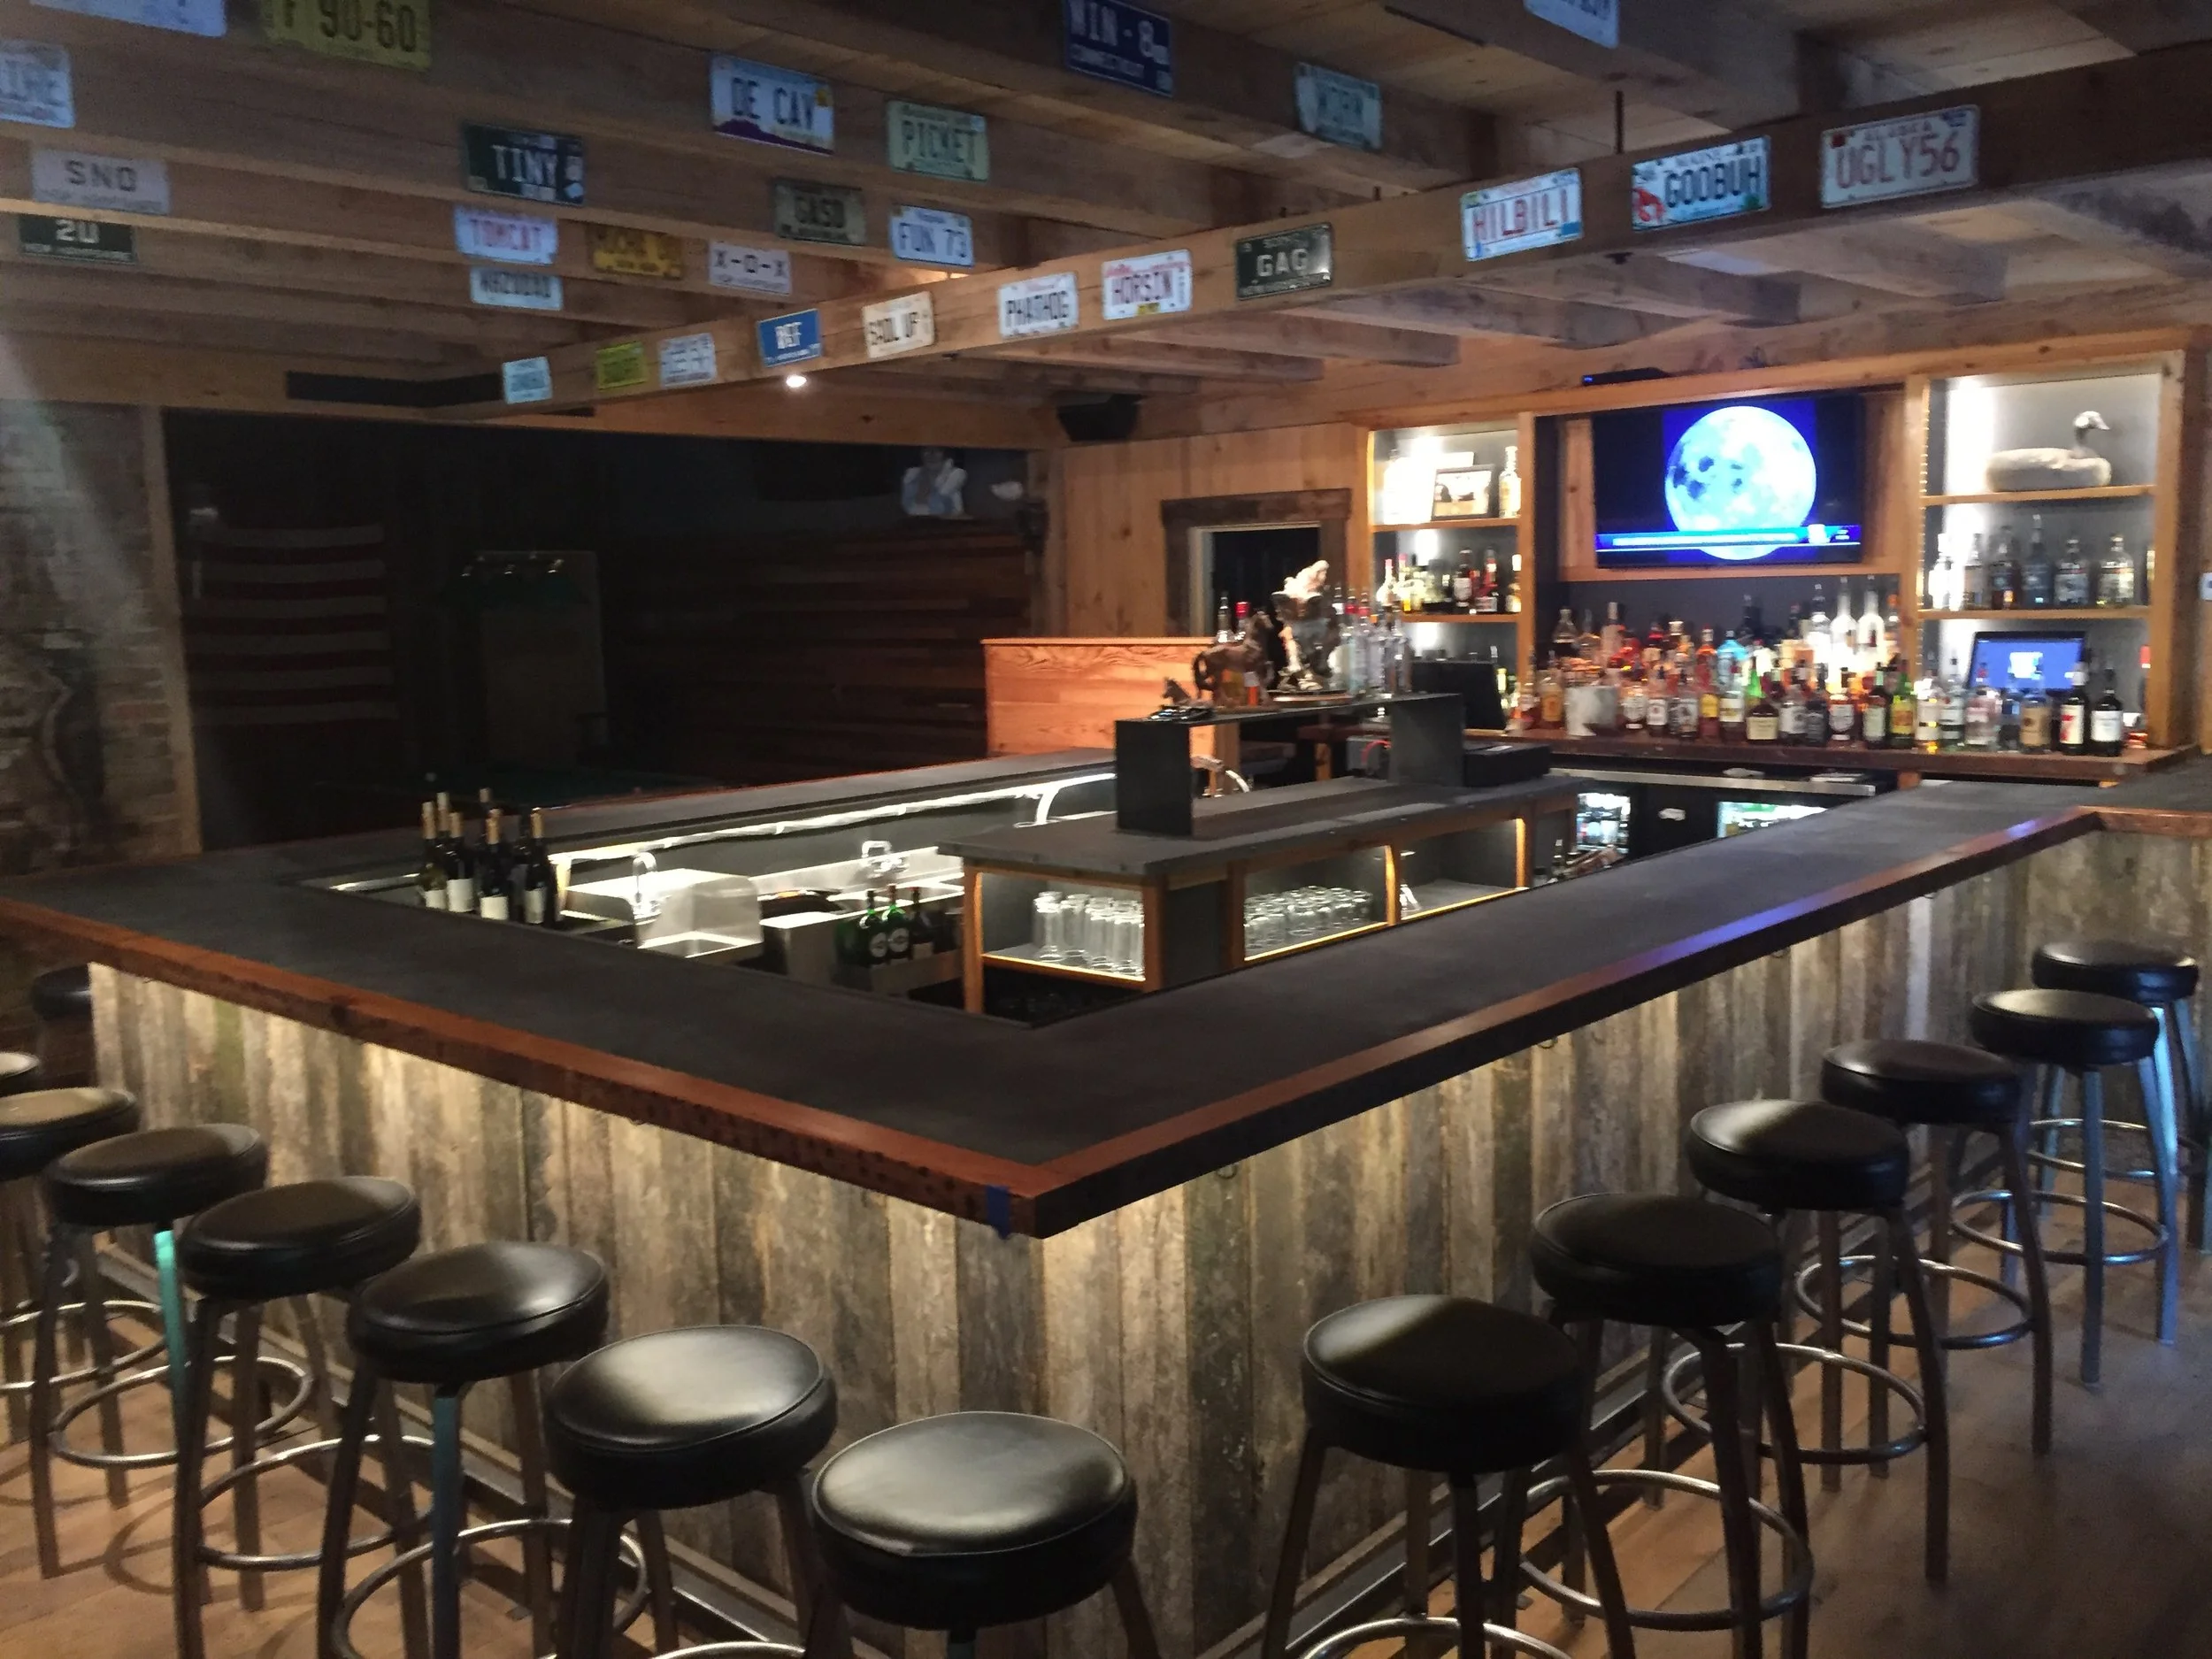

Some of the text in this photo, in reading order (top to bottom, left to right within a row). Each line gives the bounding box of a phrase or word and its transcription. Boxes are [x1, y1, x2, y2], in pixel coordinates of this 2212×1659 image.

[319, 0, 417, 52] 90-60
[731, 76, 813, 130] DE CAY
[65, 159, 136, 192] SNO
[491, 143, 557, 188] TINY
[1664, 156, 1761, 208] GOOBUH
[1836, 131, 1961, 189] UGLY56
[1472, 188, 1570, 242] HILBILI
[1256, 248, 1309, 277] GAG
